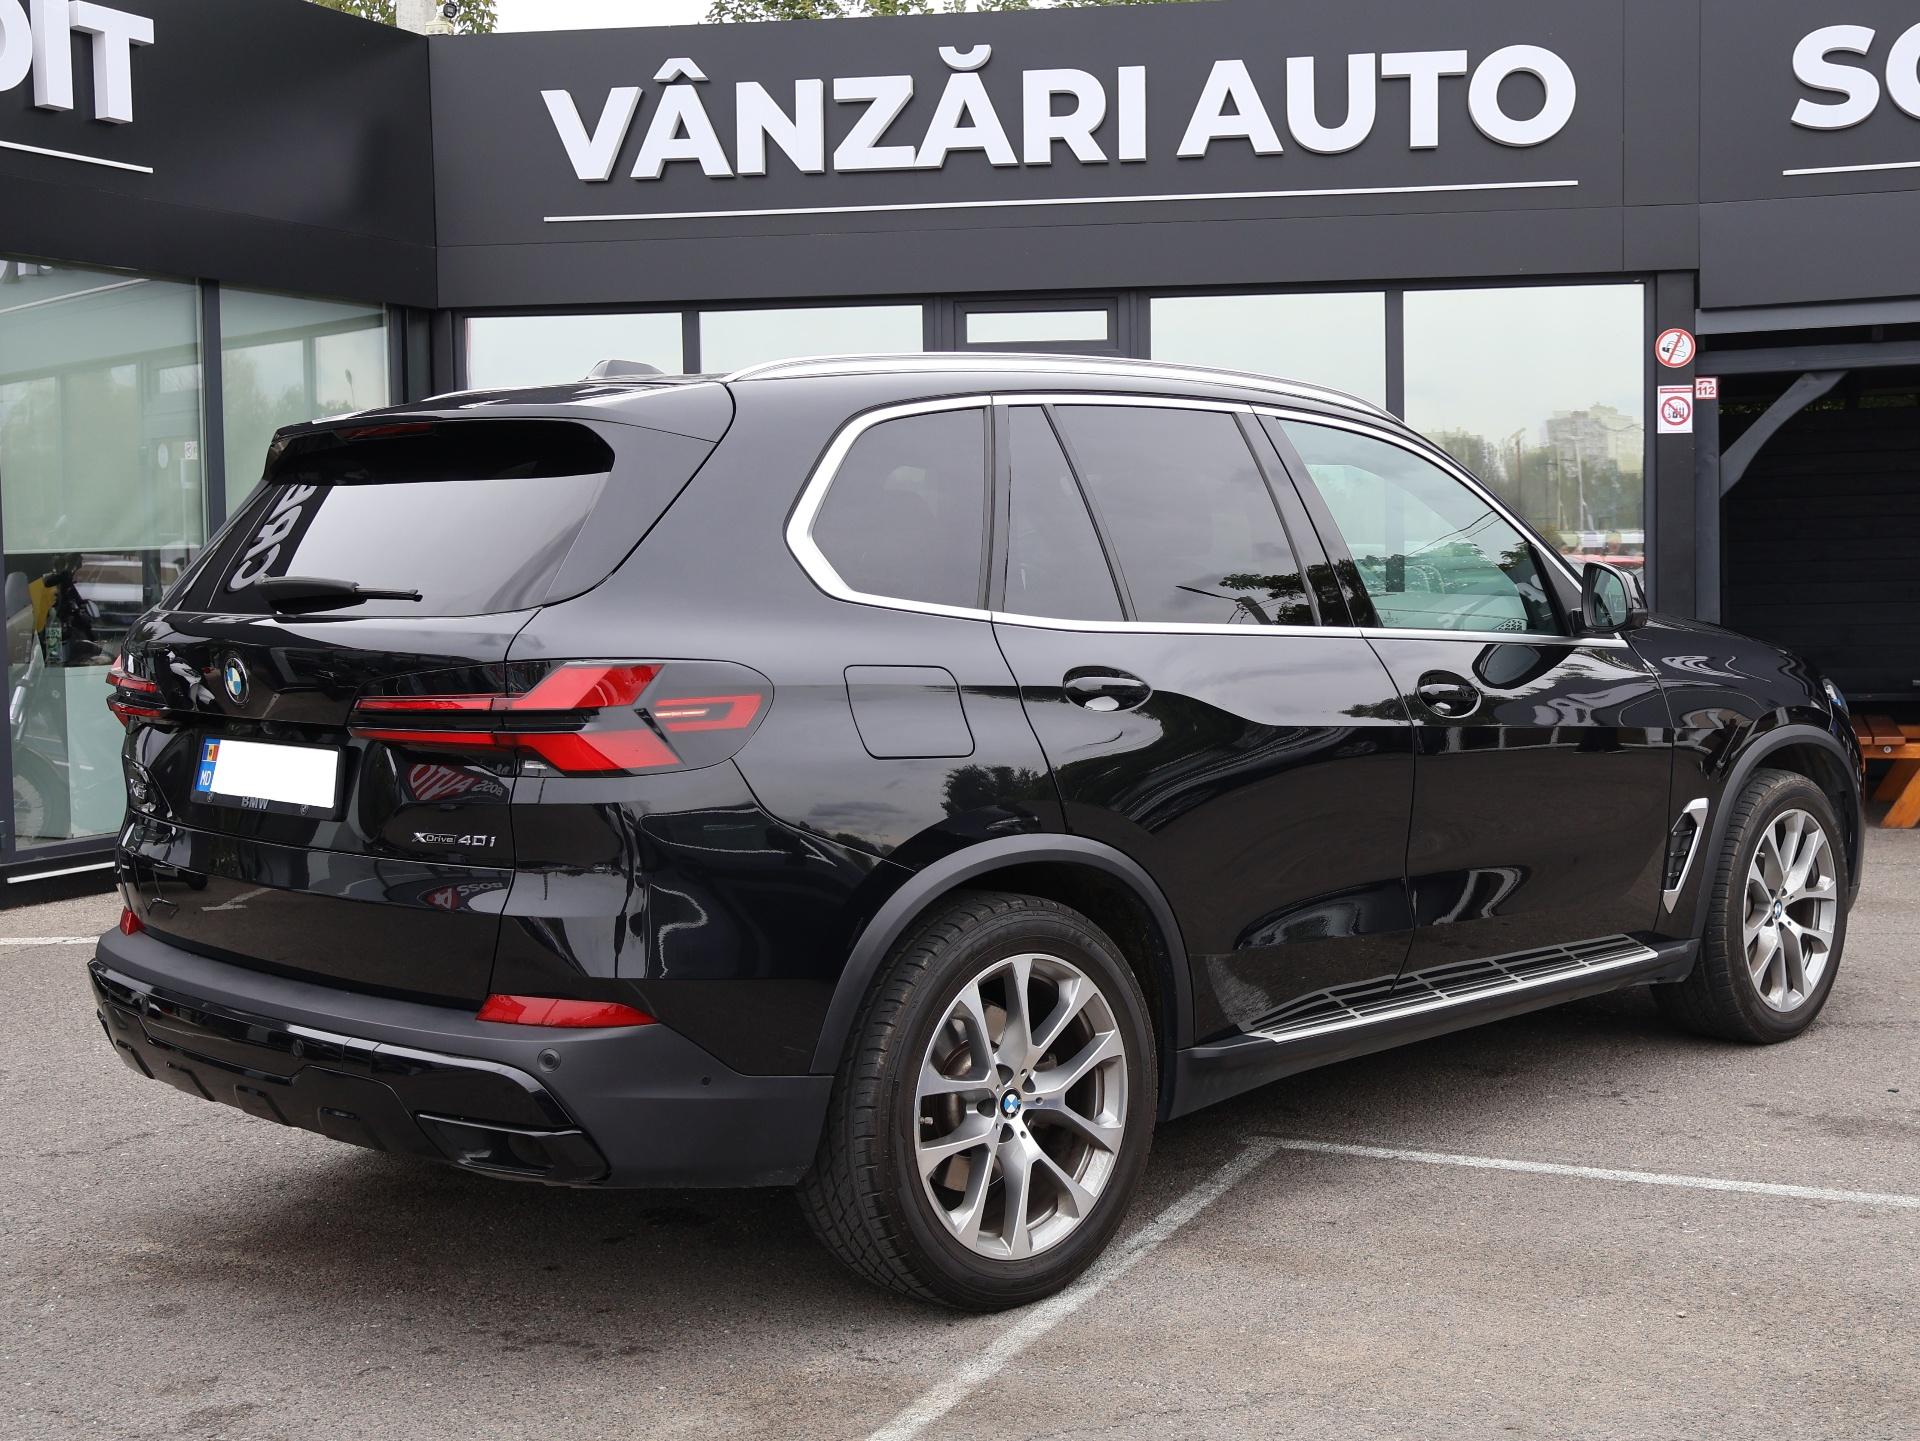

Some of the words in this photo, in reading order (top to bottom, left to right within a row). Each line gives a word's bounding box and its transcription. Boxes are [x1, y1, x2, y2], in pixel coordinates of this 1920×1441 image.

[541, 44, 1147, 182] VÂNZĂRI
[1177, 44, 1577, 158] AUTO
[1697, 386, 1715, 395] 112
[200, 769, 212, 786] MD
[241, 796, 269, 810] BMW
